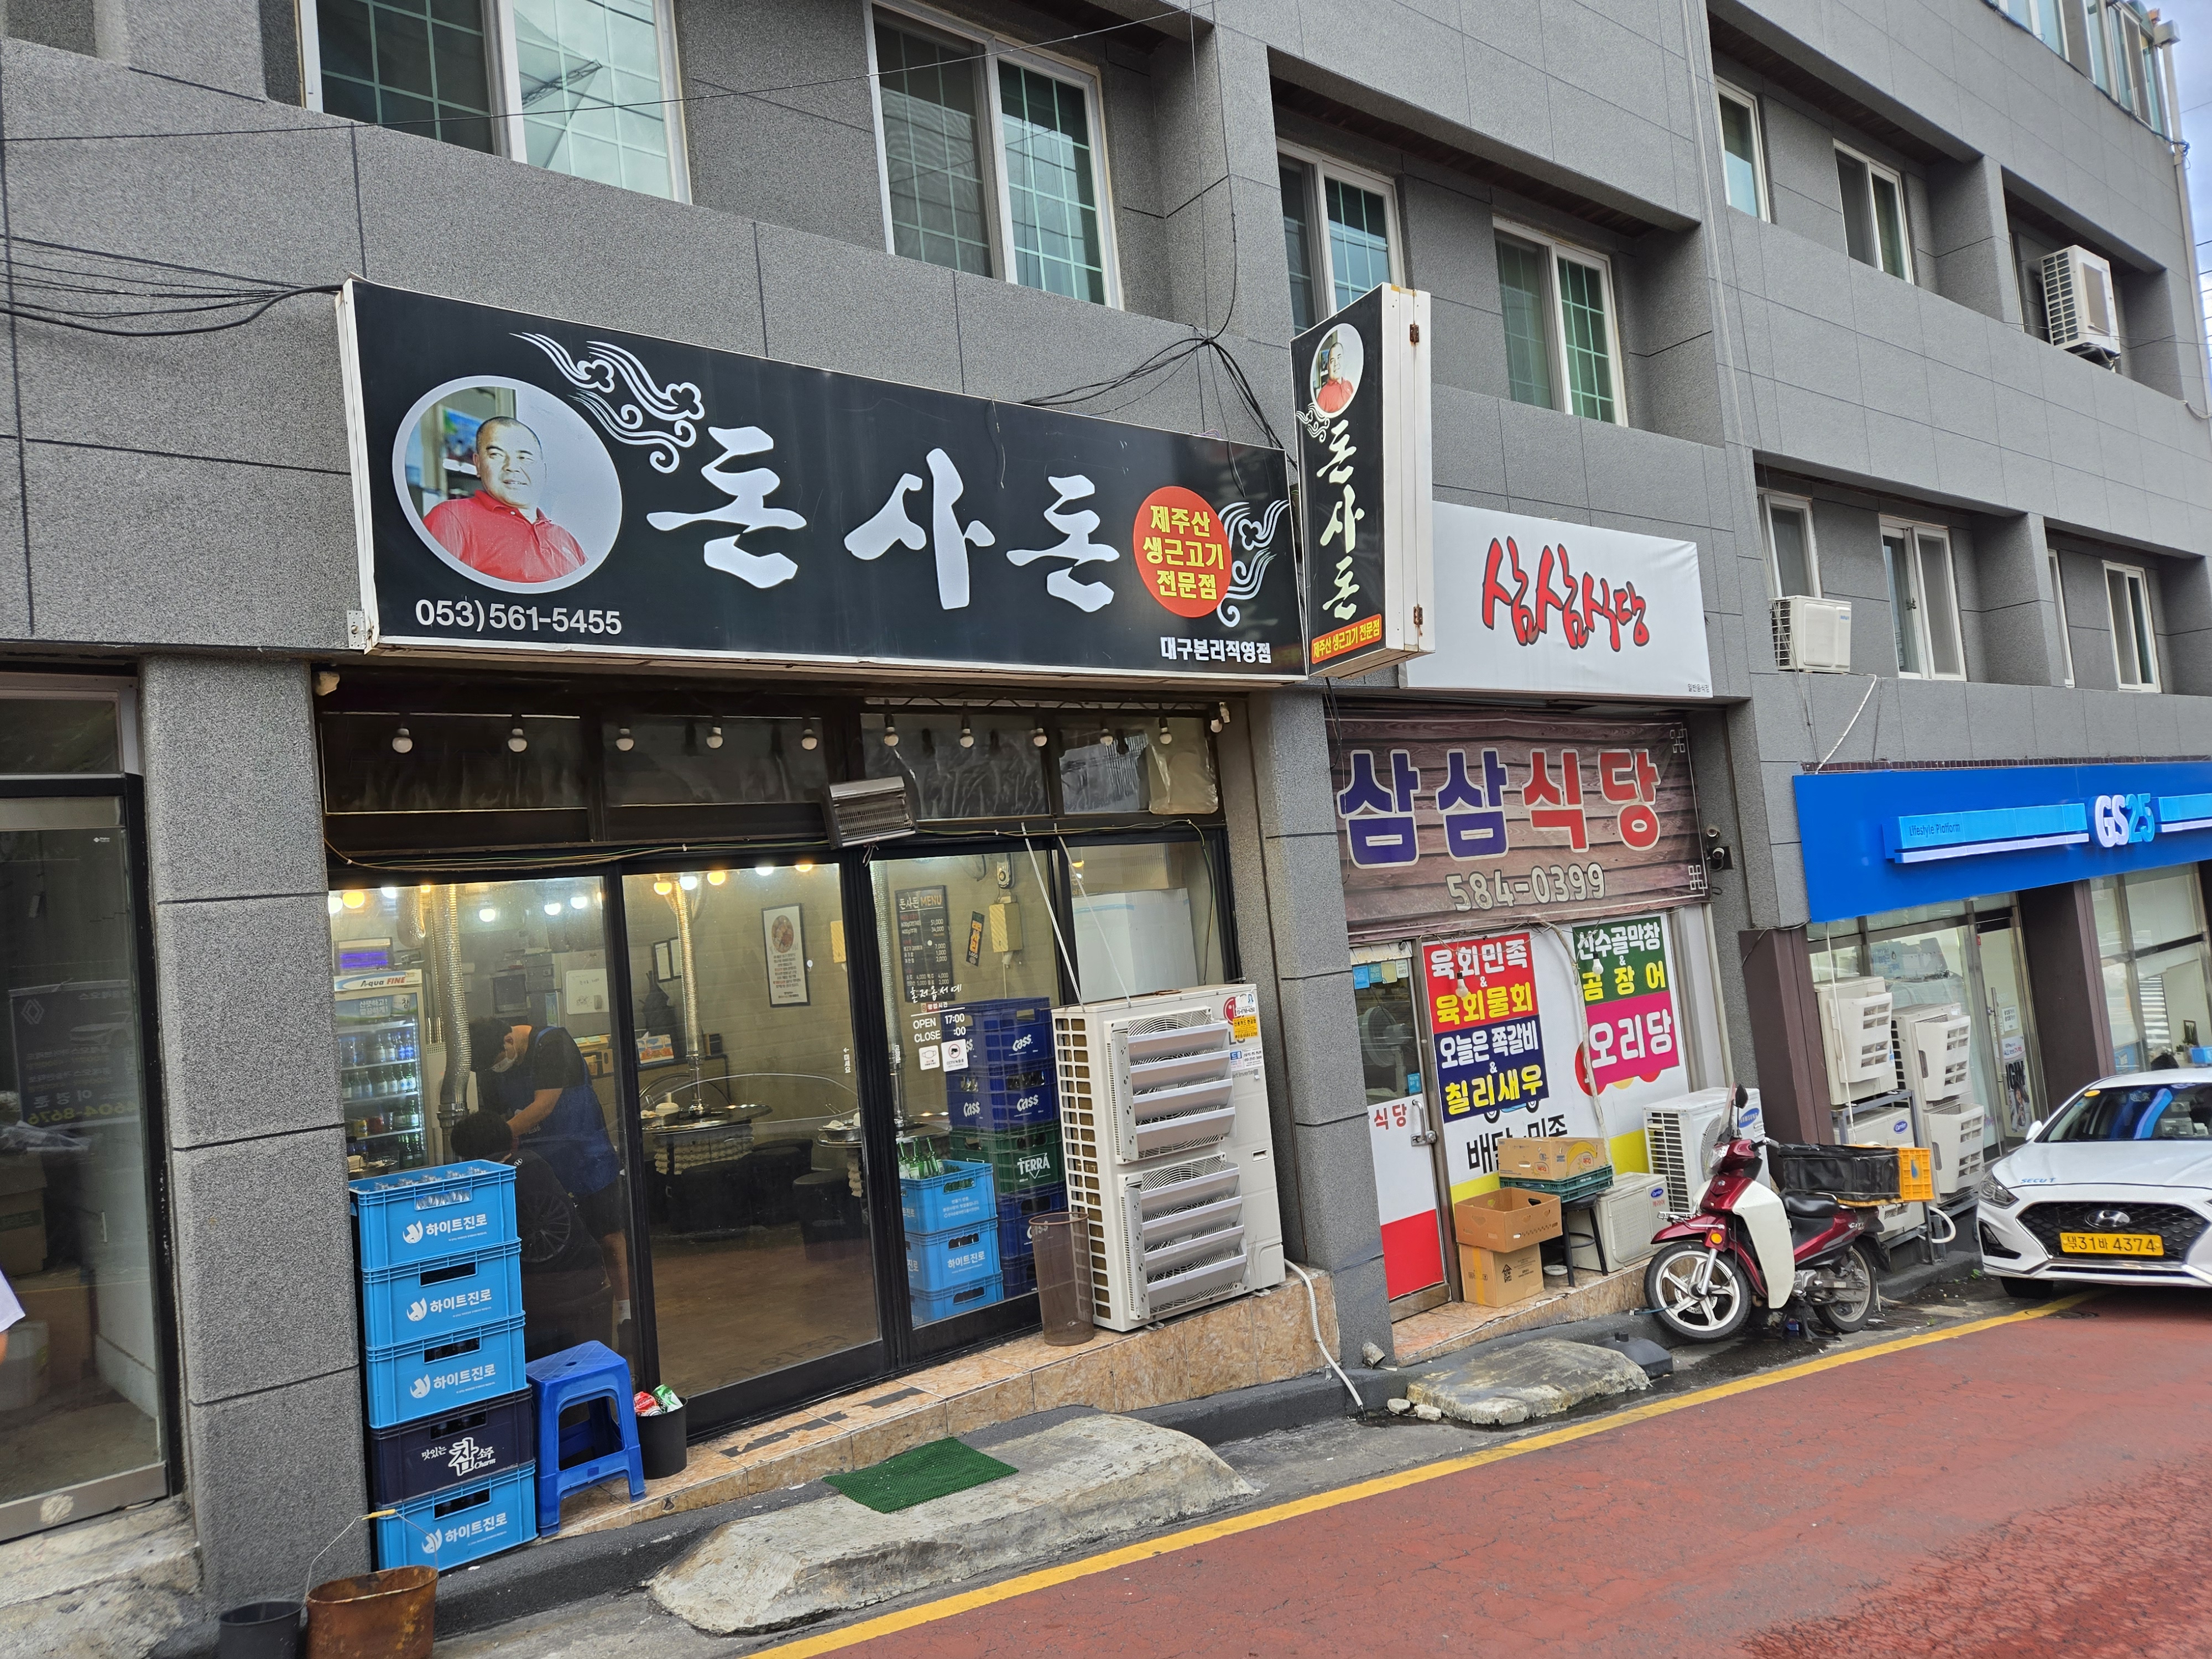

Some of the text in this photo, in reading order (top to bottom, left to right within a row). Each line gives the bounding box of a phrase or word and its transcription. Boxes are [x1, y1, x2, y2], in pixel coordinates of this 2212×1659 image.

[646, 426, 1120, 612] 돈사돈
[1150, 505, 1211, 538] 제주산
[1316, 419, 1365, 620] 돈사돈
[1143, 538, 1224, 570] 생근고기
[1156, 570, 1218, 600] 전문점
[415, 599, 622, 635] 053)561-5455
[1313, 618, 1380, 658] 제주산 생근고기 전문점
[1337, 748, 1661, 869] 삼삼식당
[1909, 822, 1961, 838] Lifestyle Platform
[2094, 793, 2155, 848] GS25
[1446, 862, 1606, 912] 584-0399
[920, 895, 942, 906] MENU
[1430, 938, 1527, 980] 육회민족
[1619, 955, 1626, 966] &
[387, 977, 406, 985] FINE
[1480, 976, 1488, 987] &
[1436, 982, 1533, 1025] 육회물회
[913, 1013, 965, 1029] OPEN 17:00
[914, 1030, 941, 1042] CLOSE
[1013, 1034, 1032, 1052] Cass
[1439, 1023, 1539, 1069] 오늘은 쪽갈비
[1589, 1009, 1673, 1069] 오리당
[1239, 1069, 1255, 1078] Inverte
[1490, 1061, 1498, 1073] &
[1444, 1065, 1543, 1116] 칠리새우
[963, 1102, 980, 1118] Cass
[1016, 1094, 1039, 1112] Cass
[1895, 1122, 1907, 1131] Carrier
[1017, 1156, 1050, 1175] TERRA
[425, 1213, 487, 1236] 하이트진로
[2113, 1238, 2156, 1253] 4374
[947, 1251, 985, 1269] 하이트진로
[430, 1288, 492, 1313] 하이트진로
[433, 1363, 496, 1391] 하이트진로
[421, 1446, 447, 1461] 맛있는
[448, 1437, 479, 1477] 참
[474, 1457, 496, 1470] Charm
[477, 1446, 494, 1460] 소주
[445, 1512, 508, 1543] 하이트진로
